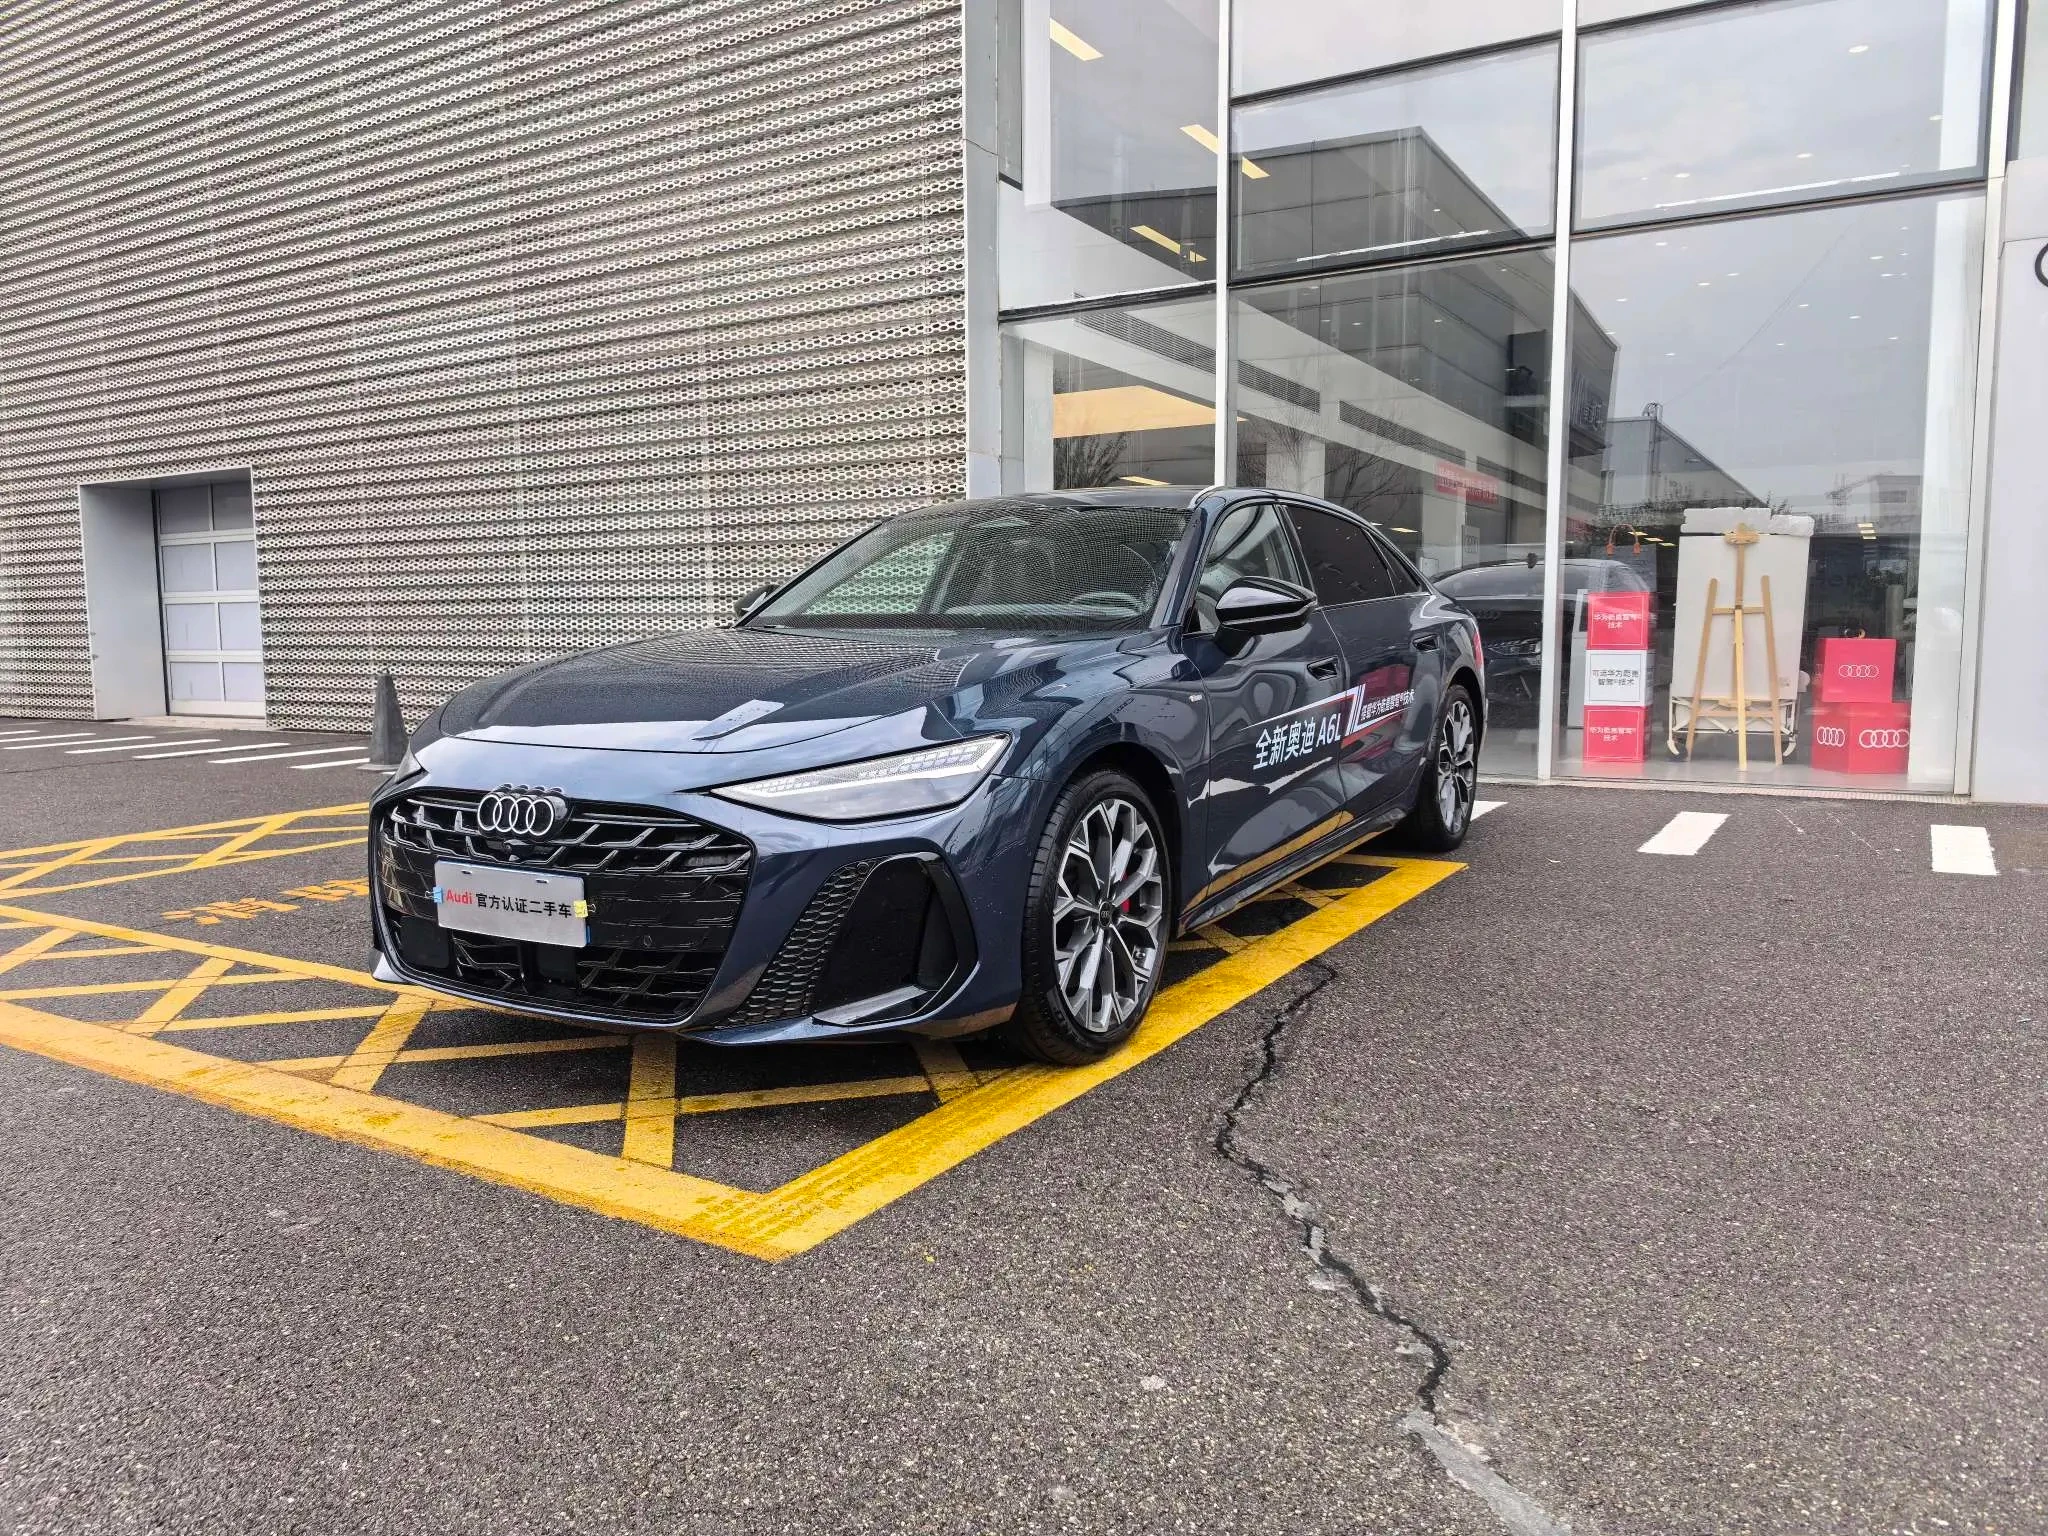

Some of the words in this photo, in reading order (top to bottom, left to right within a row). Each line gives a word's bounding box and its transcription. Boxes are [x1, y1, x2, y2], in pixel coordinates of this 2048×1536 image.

[1252, 718, 1315, 771] 全新奥迪
[1316, 712, 1342, 747] A6L
[445, 888, 473, 905] Audi
[475, 892, 572, 919] 官方认证二手车
